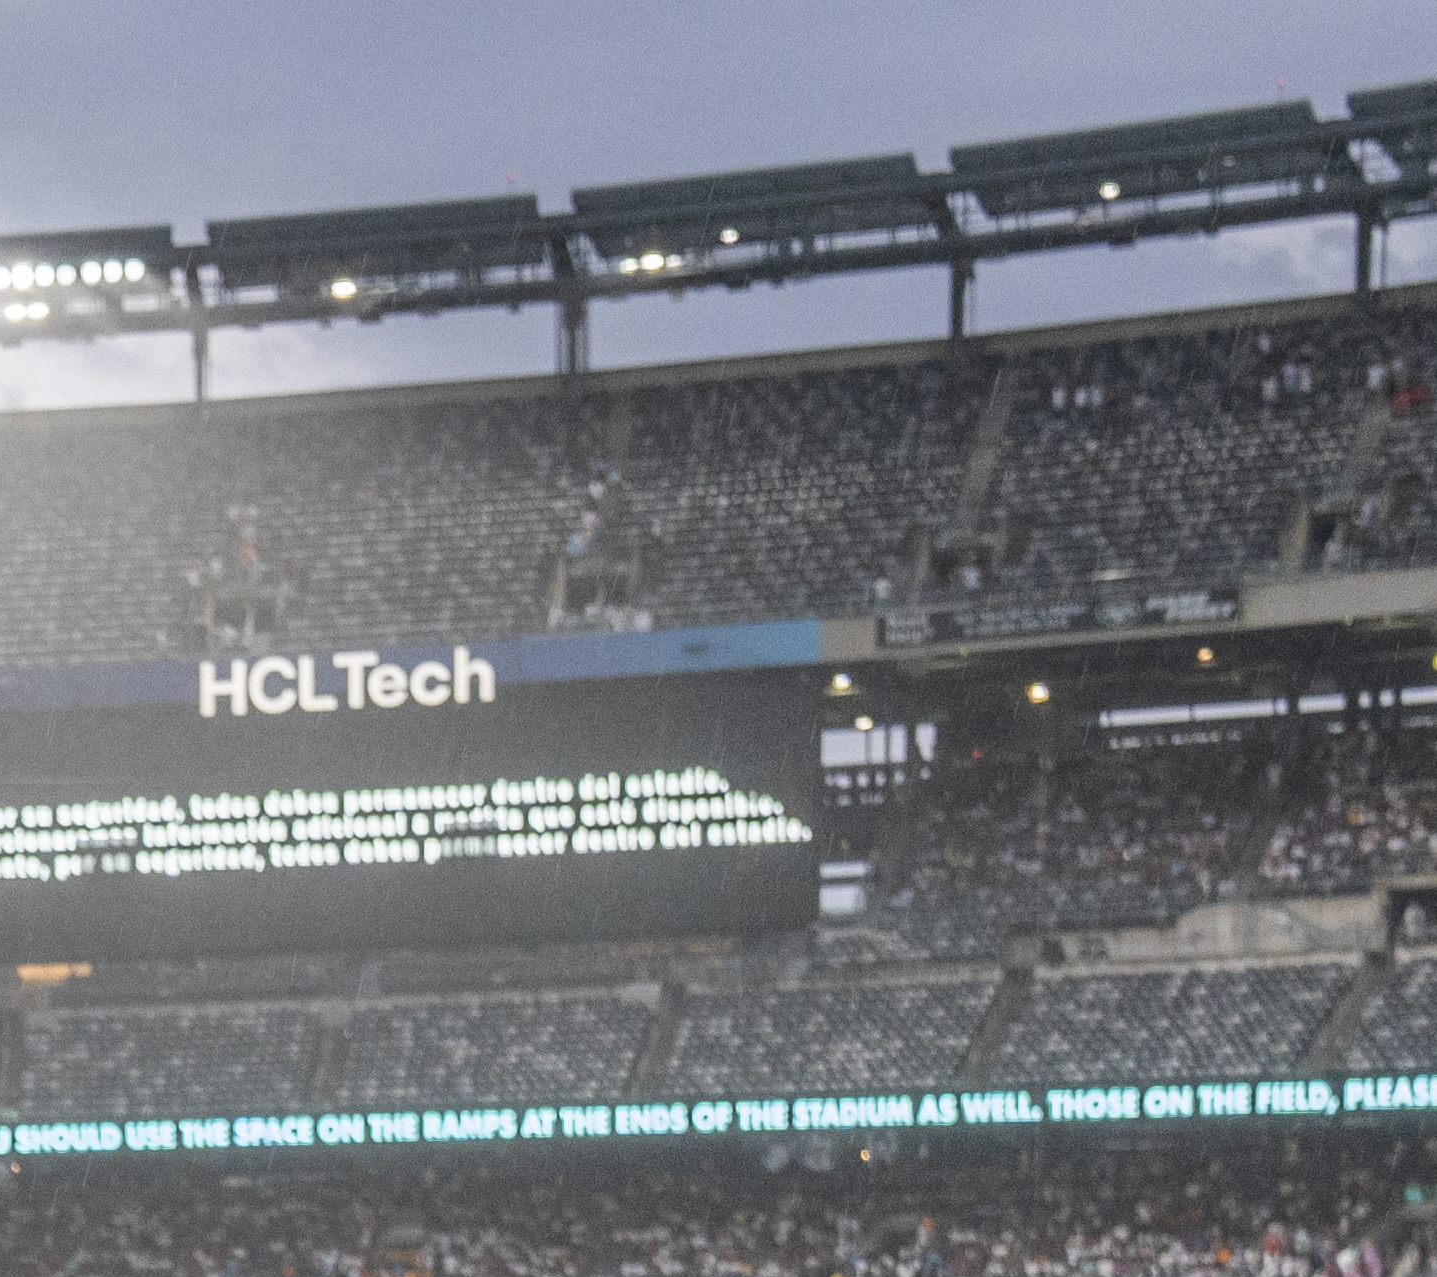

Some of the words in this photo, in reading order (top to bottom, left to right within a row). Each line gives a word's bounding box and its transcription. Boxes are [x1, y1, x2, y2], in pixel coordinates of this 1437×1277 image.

[198, 645, 496, 718] HCLTech
[14, 1121, 123, 1156] SHOULD
[125, 1120, 178, 1152] USE
[179, 1117, 230, 1150] THE
[232, 1115, 315, 1149] SPACE
[317, 1113, 365, 1146] ON
[367, 1111, 420, 1144] THE
[422, 1108, 518, 1143] RAMPS
[520, 1107, 557, 1140] AT
[559, 1105, 612, 1138] THE
[614, 1102, 689, 1136] ENDS
[692, 1101, 733, 1135] OF
[735, 1099, 789, 1133] THE
[792, 1095, 914, 1132] STADIUM
[916, 1092, 959, 1127] AS
[960, 1090, 1044, 1125] WELL.
[1047, 1086, 1140, 1123] THOSE
[1143, 1085, 1194, 1120] ON
[1197, 1082, 1252, 1117] THE
[1256, 1079, 1339, 1117] FIELD,
[1342, 1074, 1437, 1112] PLEAS
